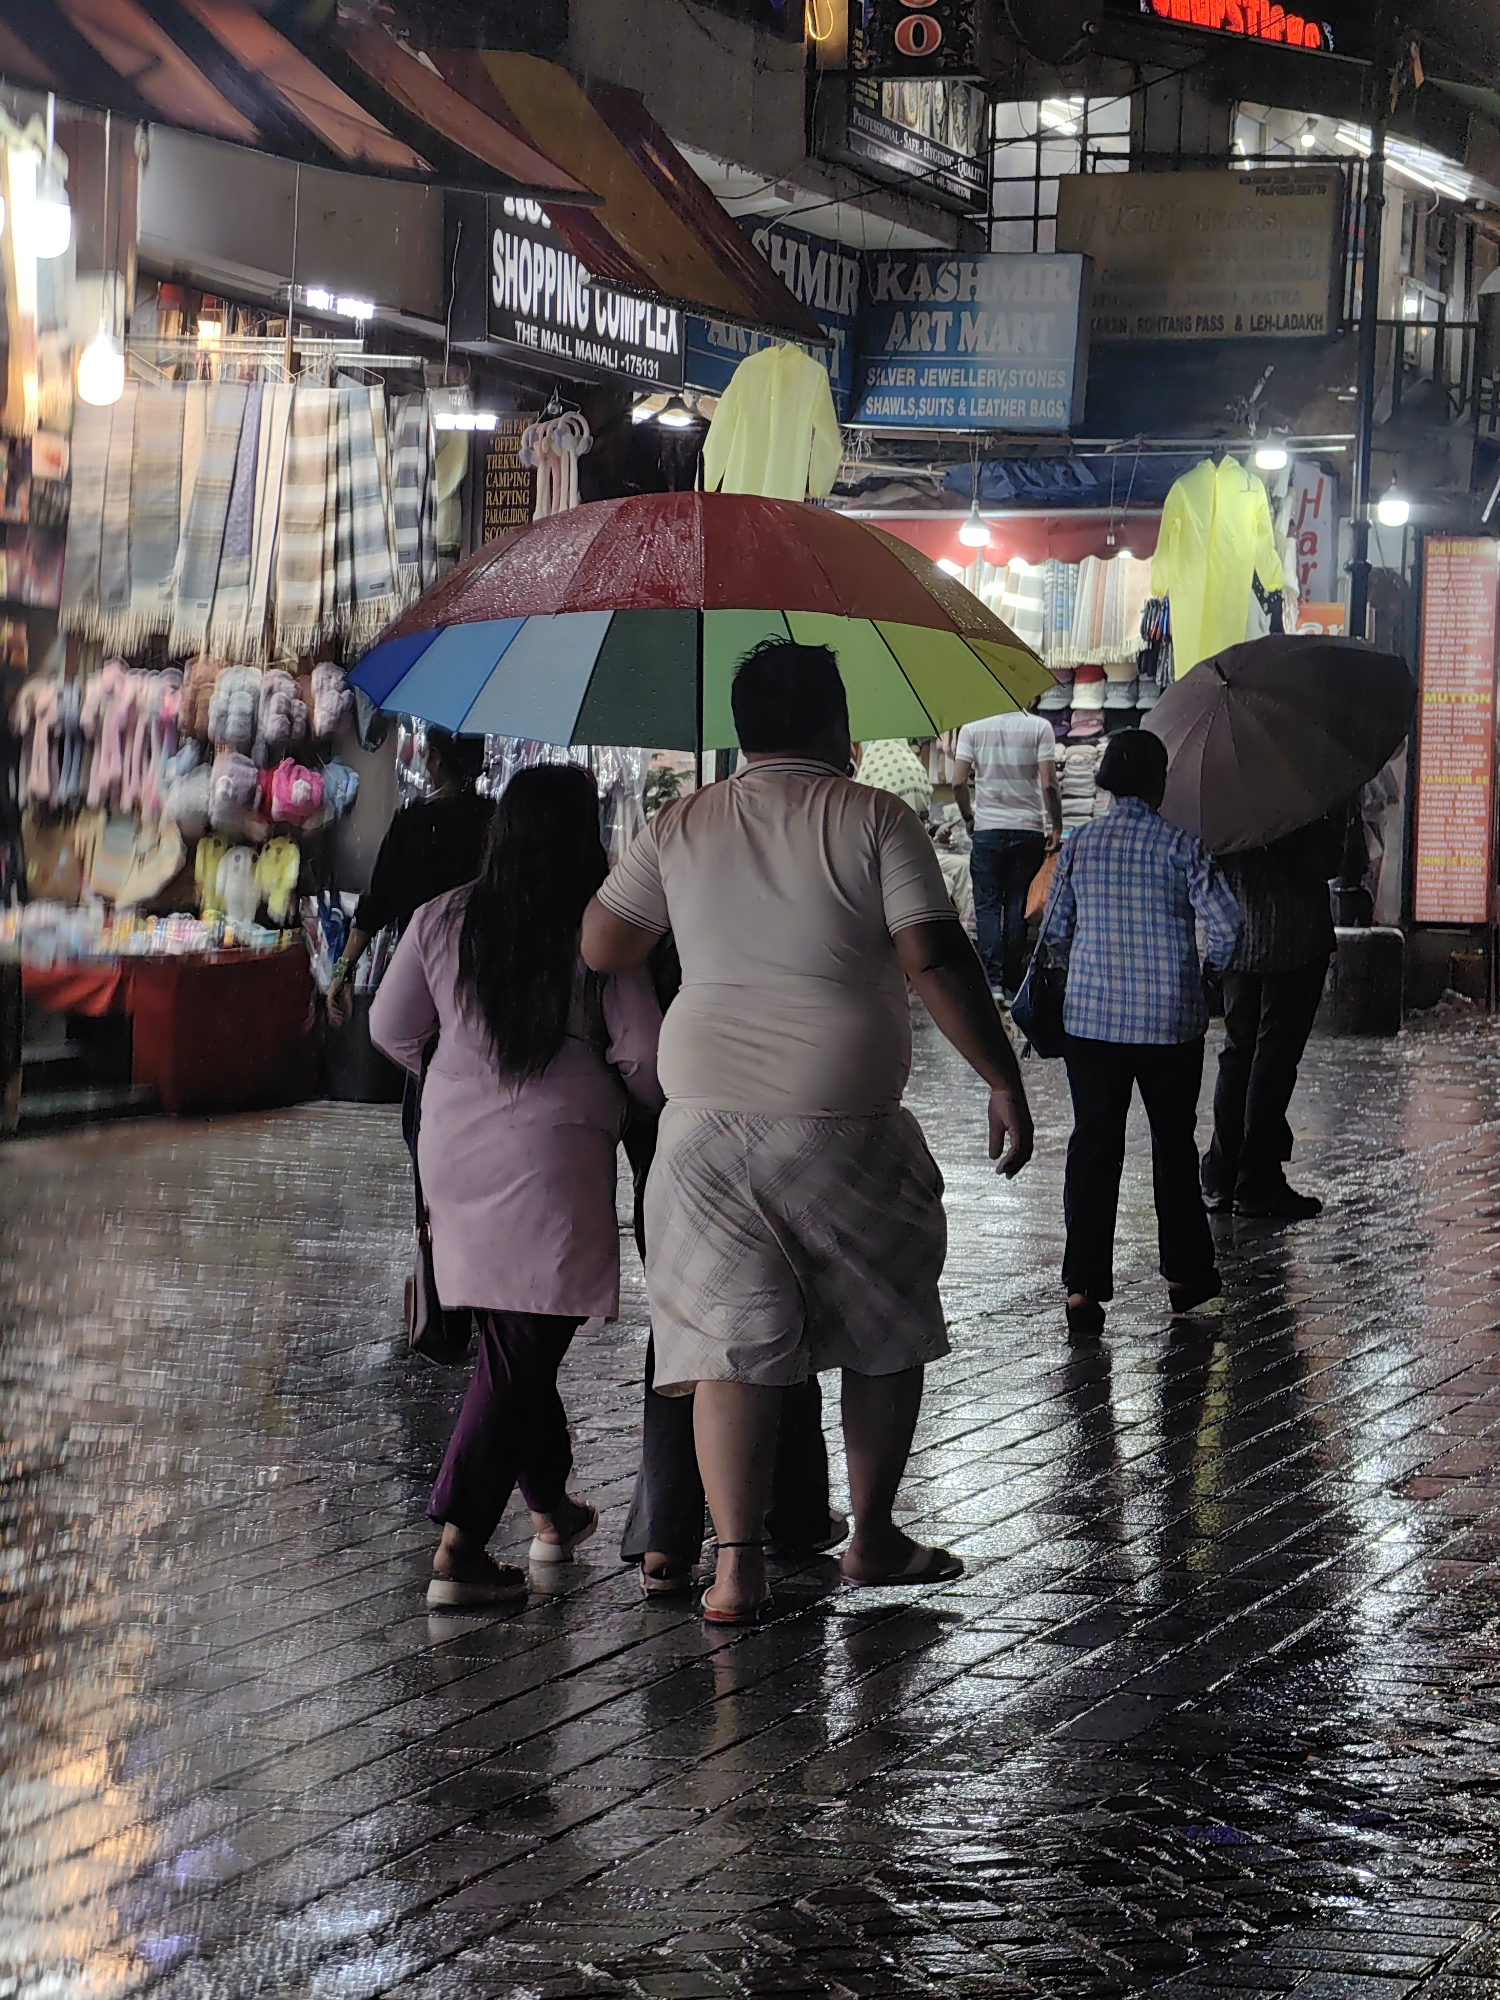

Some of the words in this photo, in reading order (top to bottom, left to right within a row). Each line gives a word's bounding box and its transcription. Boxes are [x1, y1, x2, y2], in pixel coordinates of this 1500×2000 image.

[903, 132, 920, 154] SAFE
[492, 229, 590, 332] SHOPPING
[872, 262, 1071, 301] KASHMIR
[595, 286, 679, 355] COMPLEX
[1195, 314, 1225, 333] PASS
[1250, 313, 1324, 332] LEH-LADAKH
[884, 311, 953, 352] ART
[957, 311, 1056, 353] MART
[515, 320, 538, 345] THE
[540, 328, 573, 357] MALL
[575, 338, 619, 371] MANALI
[866, 367, 916, 388] SILVER
[957, 399, 967, 417] &
[970, 398, 1026, 418] LEATHER
[495, 436, 522, 451] OFFER
[486, 453, 527, 470] TREKKIN
[485, 471, 531, 488] CAMPING
[485, 489, 530, 506] RAFTING
[485, 507, 529, 524] PARAGLIDING
[1424, 693, 1491, 704] MUTTON
[1421, 775, 1472, 784] TANDOOR
[1461, 856, 1486, 867] FOOD
